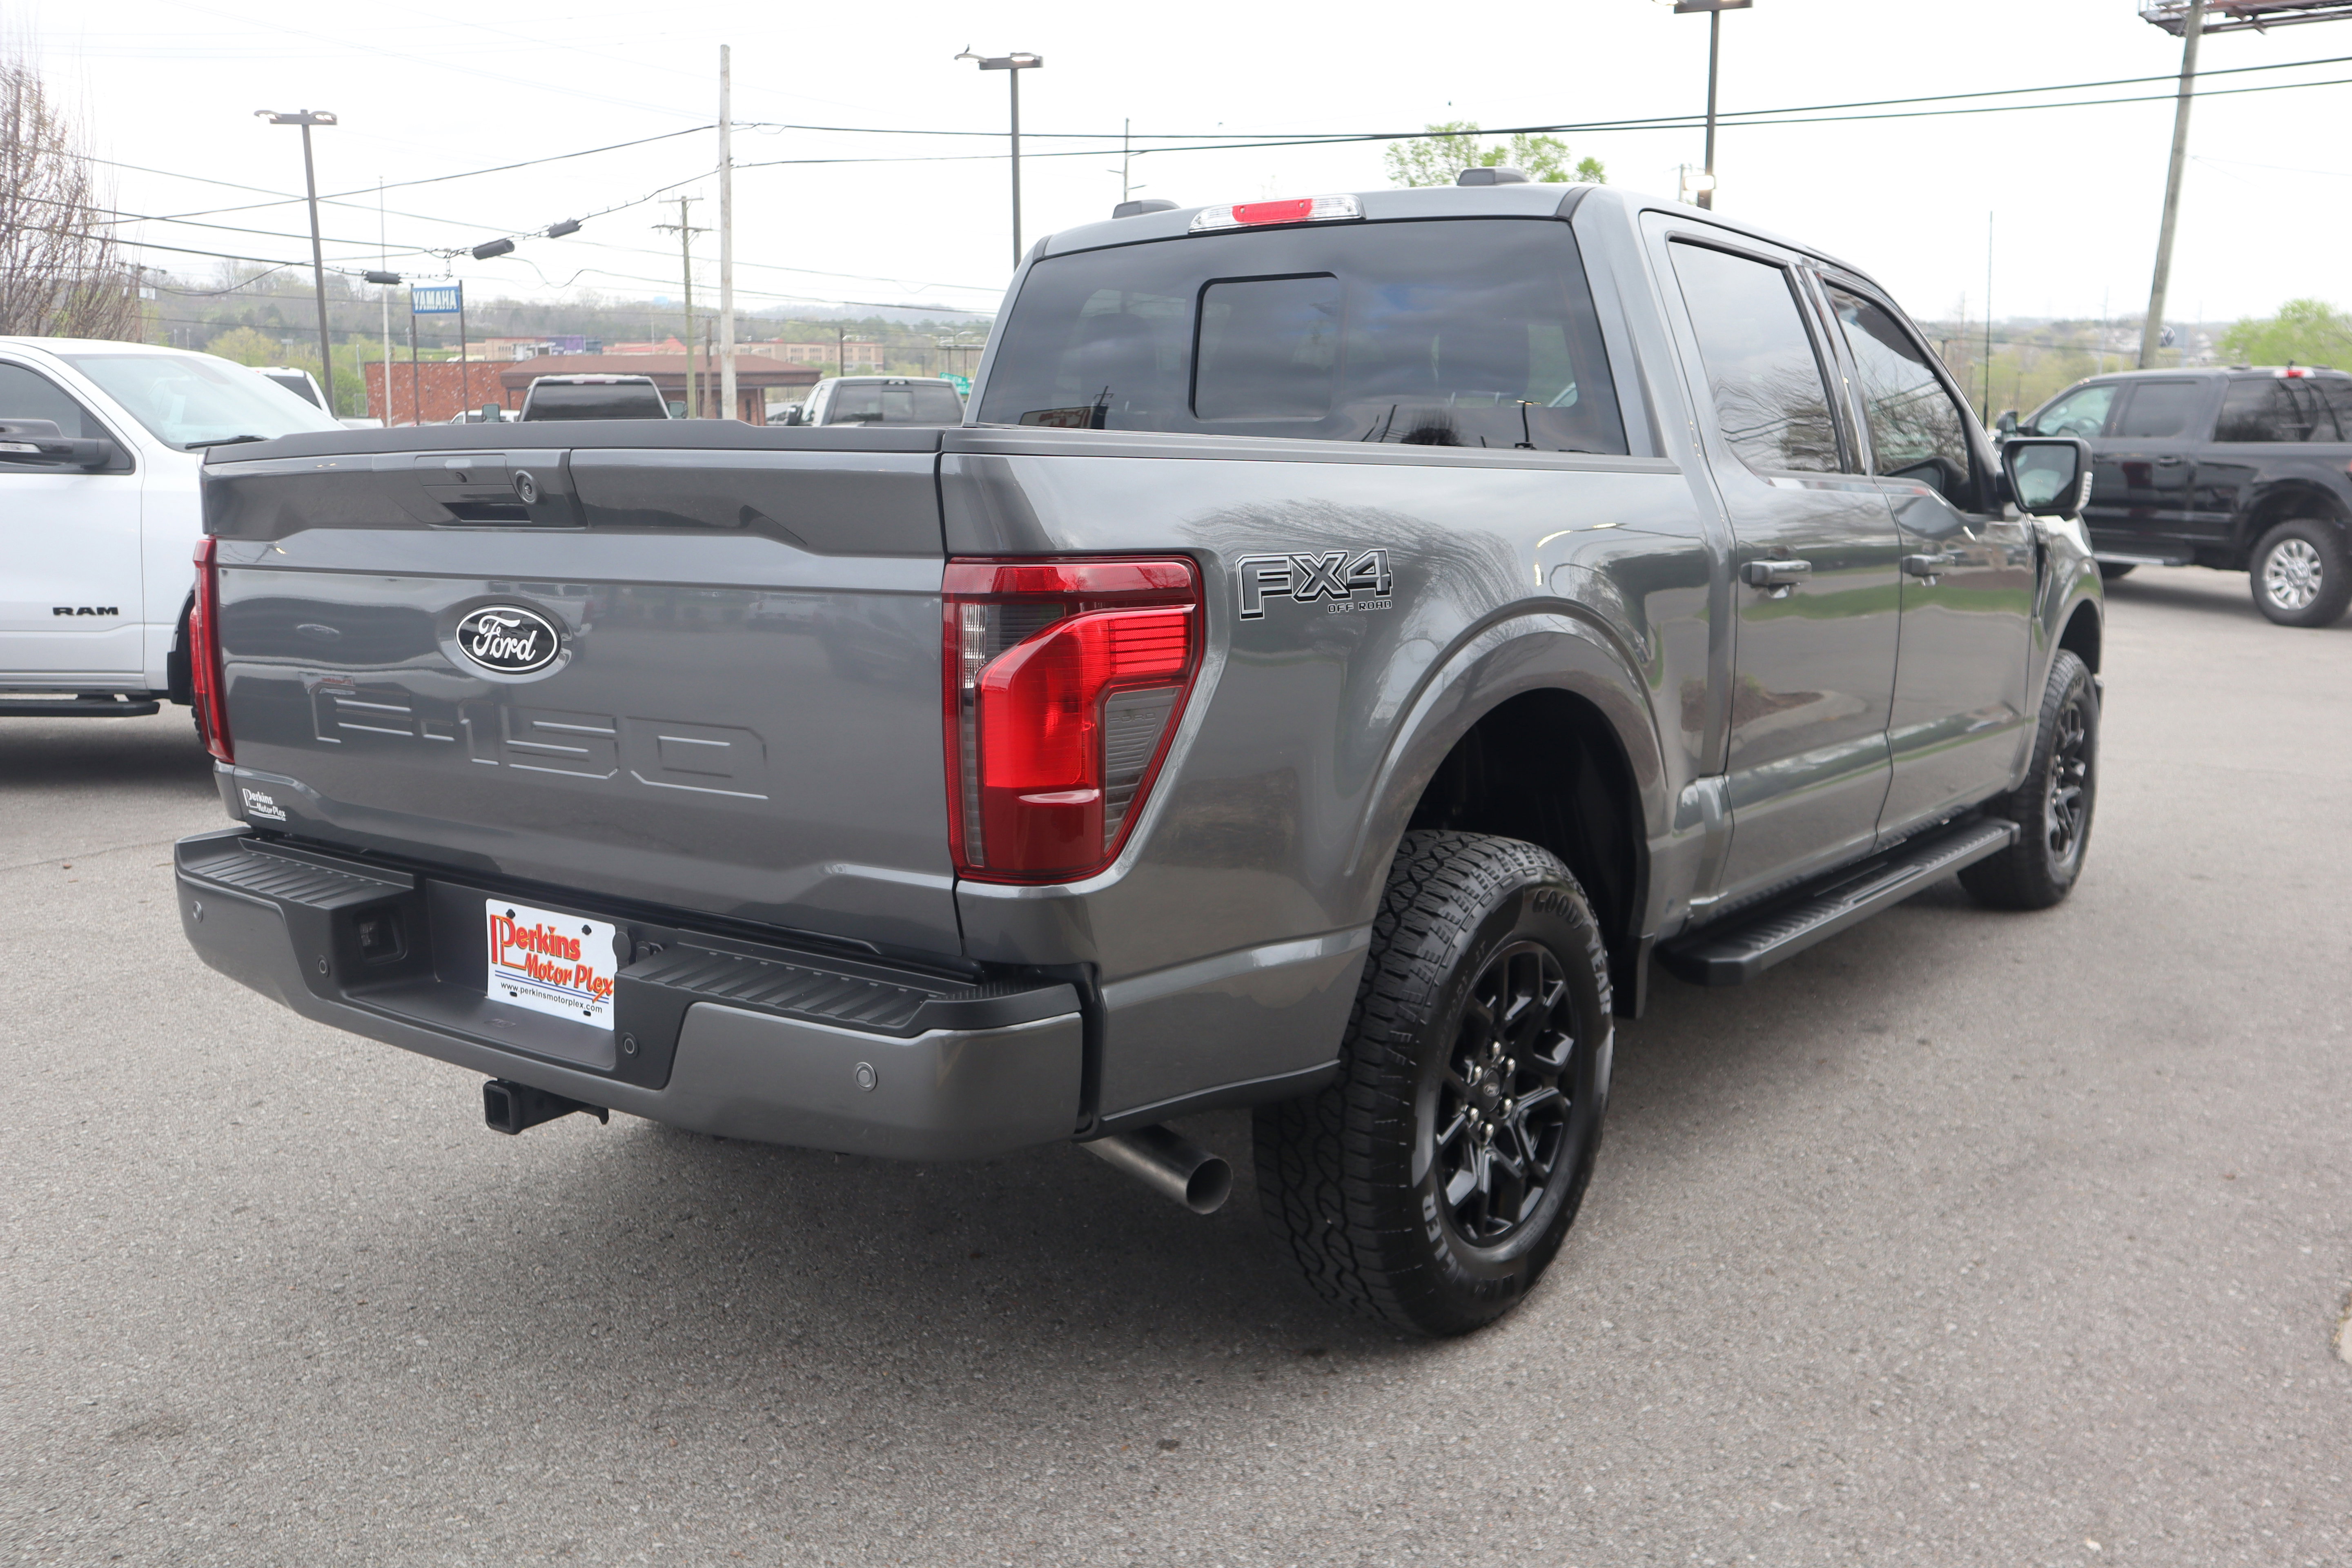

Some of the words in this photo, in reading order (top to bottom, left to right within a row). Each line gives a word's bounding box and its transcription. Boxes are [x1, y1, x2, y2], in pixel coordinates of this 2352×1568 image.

[412, 290, 457, 311] YAMAHA
[1236, 548, 1393, 621] FX4
[53, 607, 118, 615] RAM
[1328, 603, 1354, 613] OFF
[1359, 599, 1392, 611] ROAD
[472, 615, 537, 661] Ford
[1107, 713, 1156, 724] FORD
[310, 683, 768, 799] F-150
[242, 788, 273, 806] Perkins
[490, 914, 581, 963] Perkins
[524, 953, 572, 985] Motor
[574, 964, 614, 1003] Plex
[501, 982, 603, 1013] www.perkinsmotorplex.com
